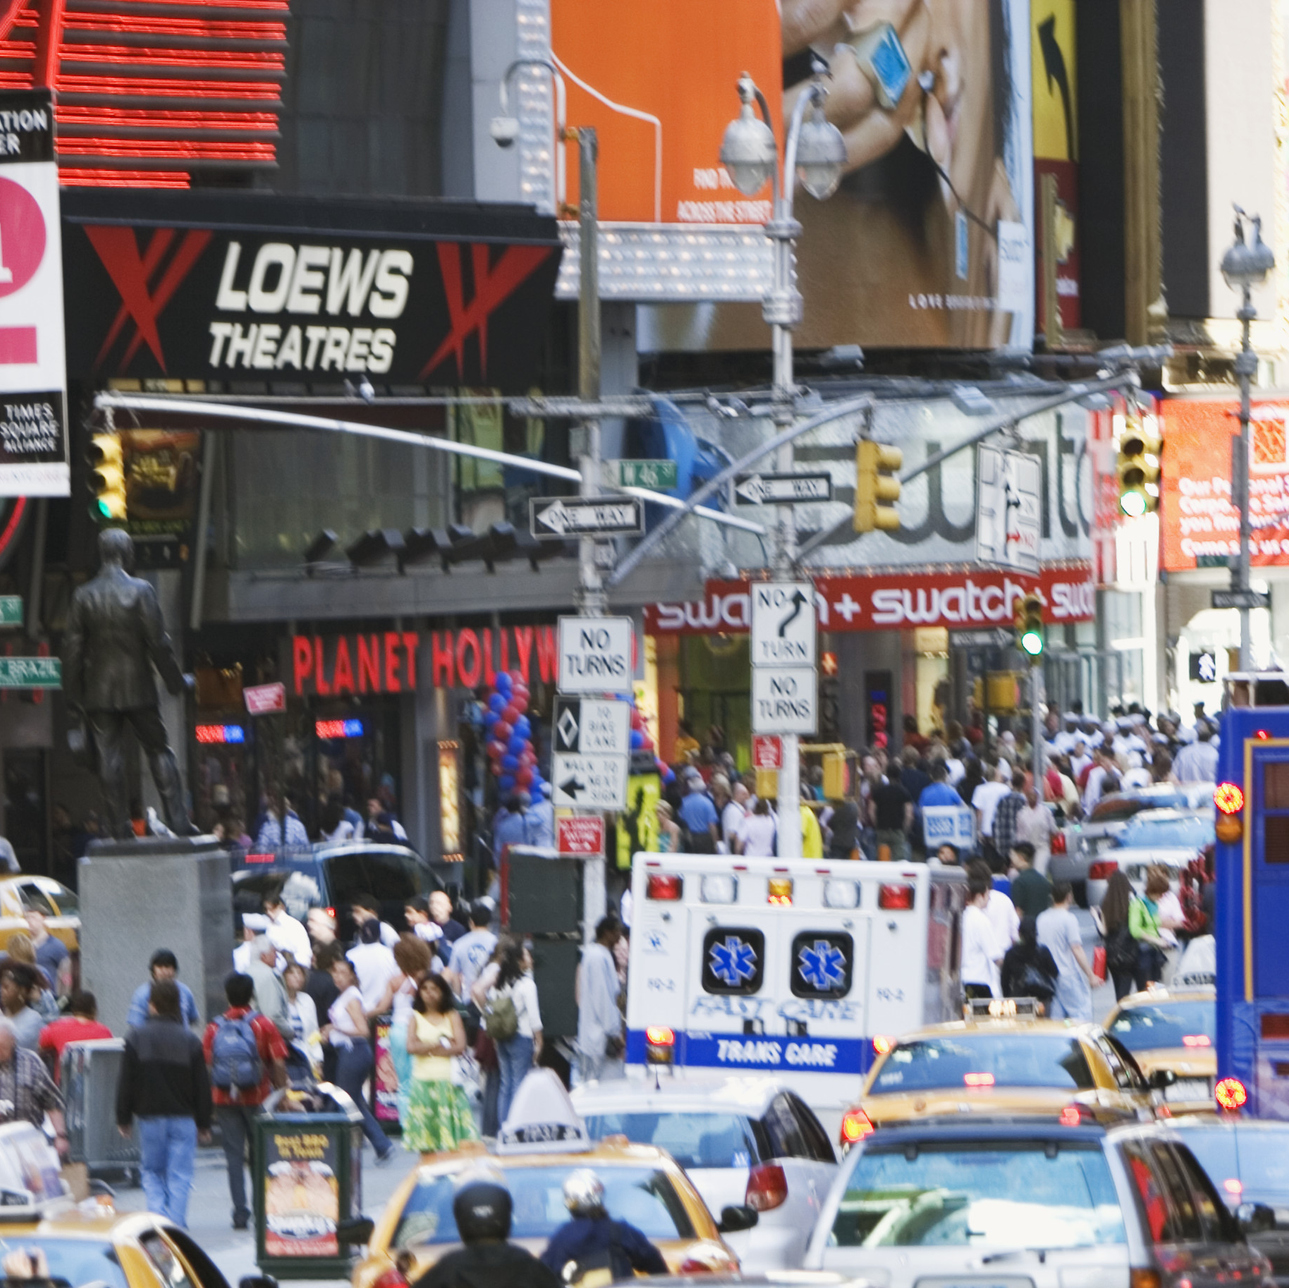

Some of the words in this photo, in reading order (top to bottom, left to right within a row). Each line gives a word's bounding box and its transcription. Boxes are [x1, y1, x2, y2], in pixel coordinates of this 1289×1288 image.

[215, 240, 414, 319] LOEWS
[209, 322, 396, 375] THEATRES
[4, 402, 54, 420] TIMES
[0, 420, 60, 440] SQUARE
[3, 438, 57, 453] ALLIANCE
[622, 461, 635, 484] W
[640, 461, 659, 486] 46
[748, 481, 772, 497] ONE
[792, 480, 821, 498] WAY
[548, 508, 579, 525] ONE
[595, 506, 627, 526] WAY
[1181, 538, 1226, 557] Come
[758, 587, 785, 608] NO
[872, 577, 1024, 624] swatch
[581, 629, 610, 650] NO
[760, 641, 808, 658] TURN
[8, 659, 57, 678] BRAZIL
[293, 632, 419, 695] PLANET
[565, 655, 625, 677] TURNS
[769, 676, 797, 695] NO
[758, 700, 810, 719] TURNS
[717, 1039, 781, 1065] TRANS
[785, 1042, 838, 1068] CARE
